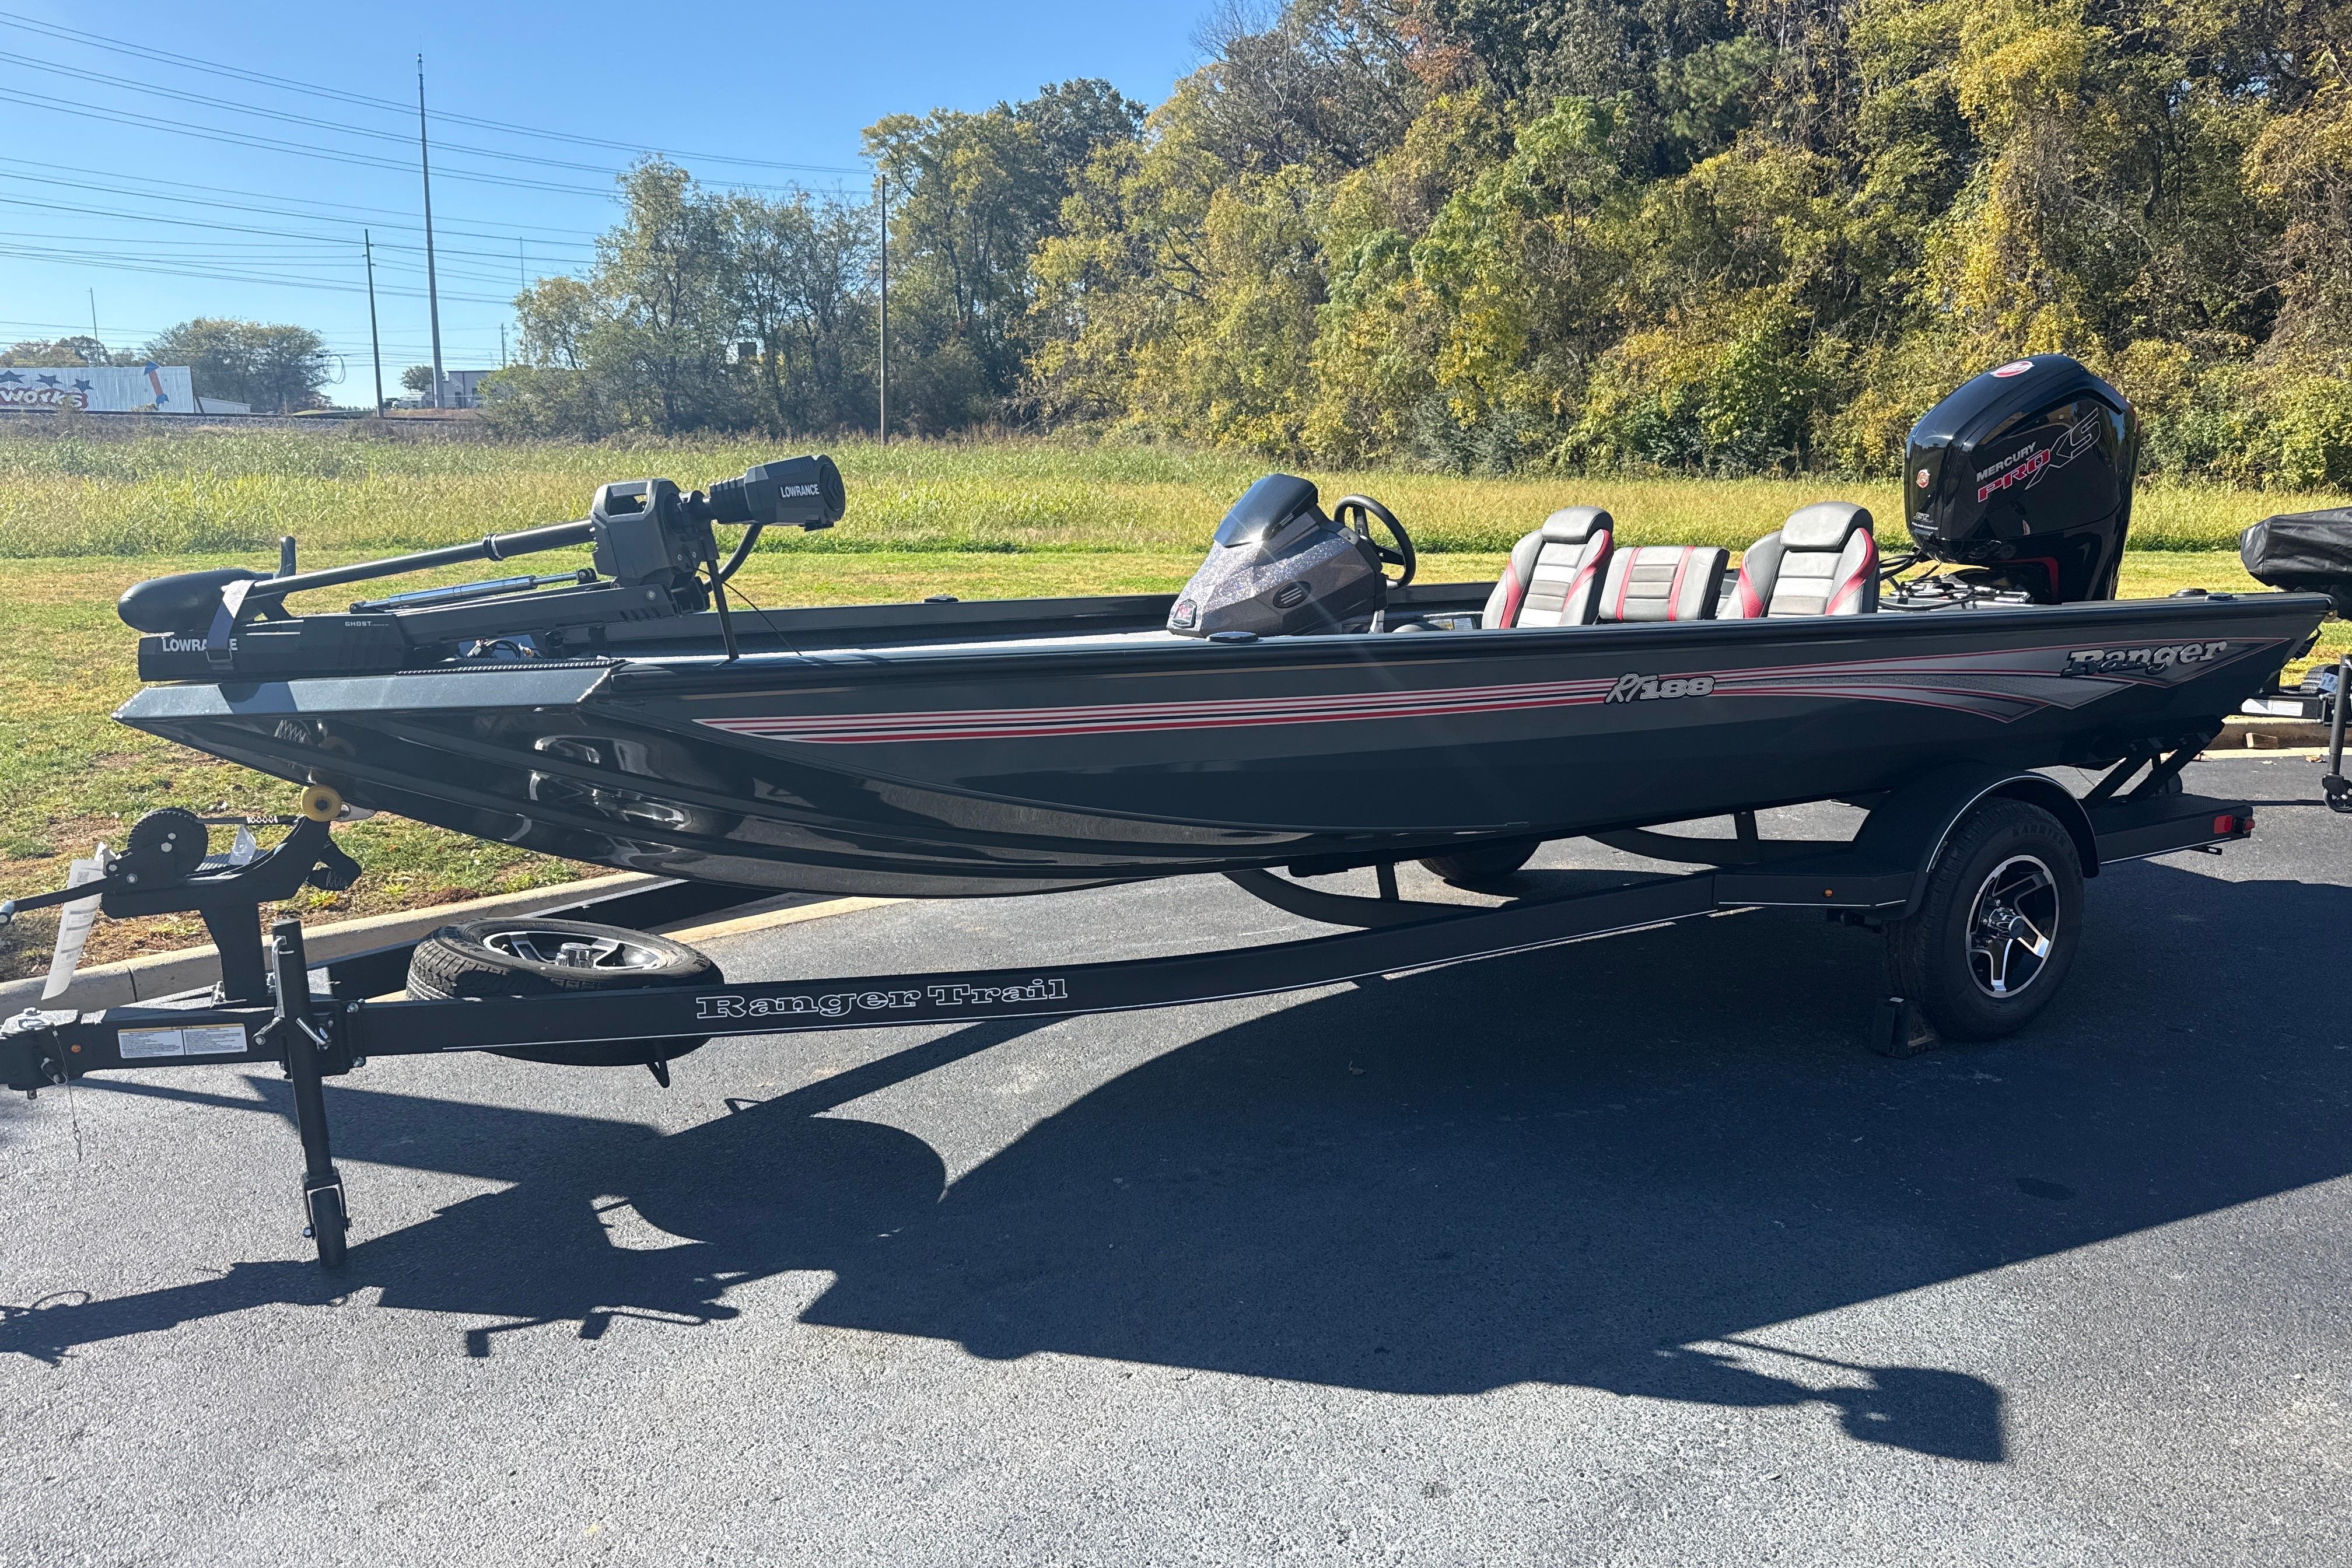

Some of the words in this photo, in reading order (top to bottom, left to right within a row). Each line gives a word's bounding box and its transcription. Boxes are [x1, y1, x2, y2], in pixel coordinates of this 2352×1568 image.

[1976, 442, 2036, 482] MERCURY
[1978, 448, 2050, 503] PRO
[2024, 407, 2101, 490] XS
[780, 484, 820, 498] LOWRANCE
[162, 638, 238, 652] LOWRAE
[2063, 640, 2228, 677] Ranger
[696, 991, 921, 1018] Ranger
[927, 978, 1069, 1006] Trail
